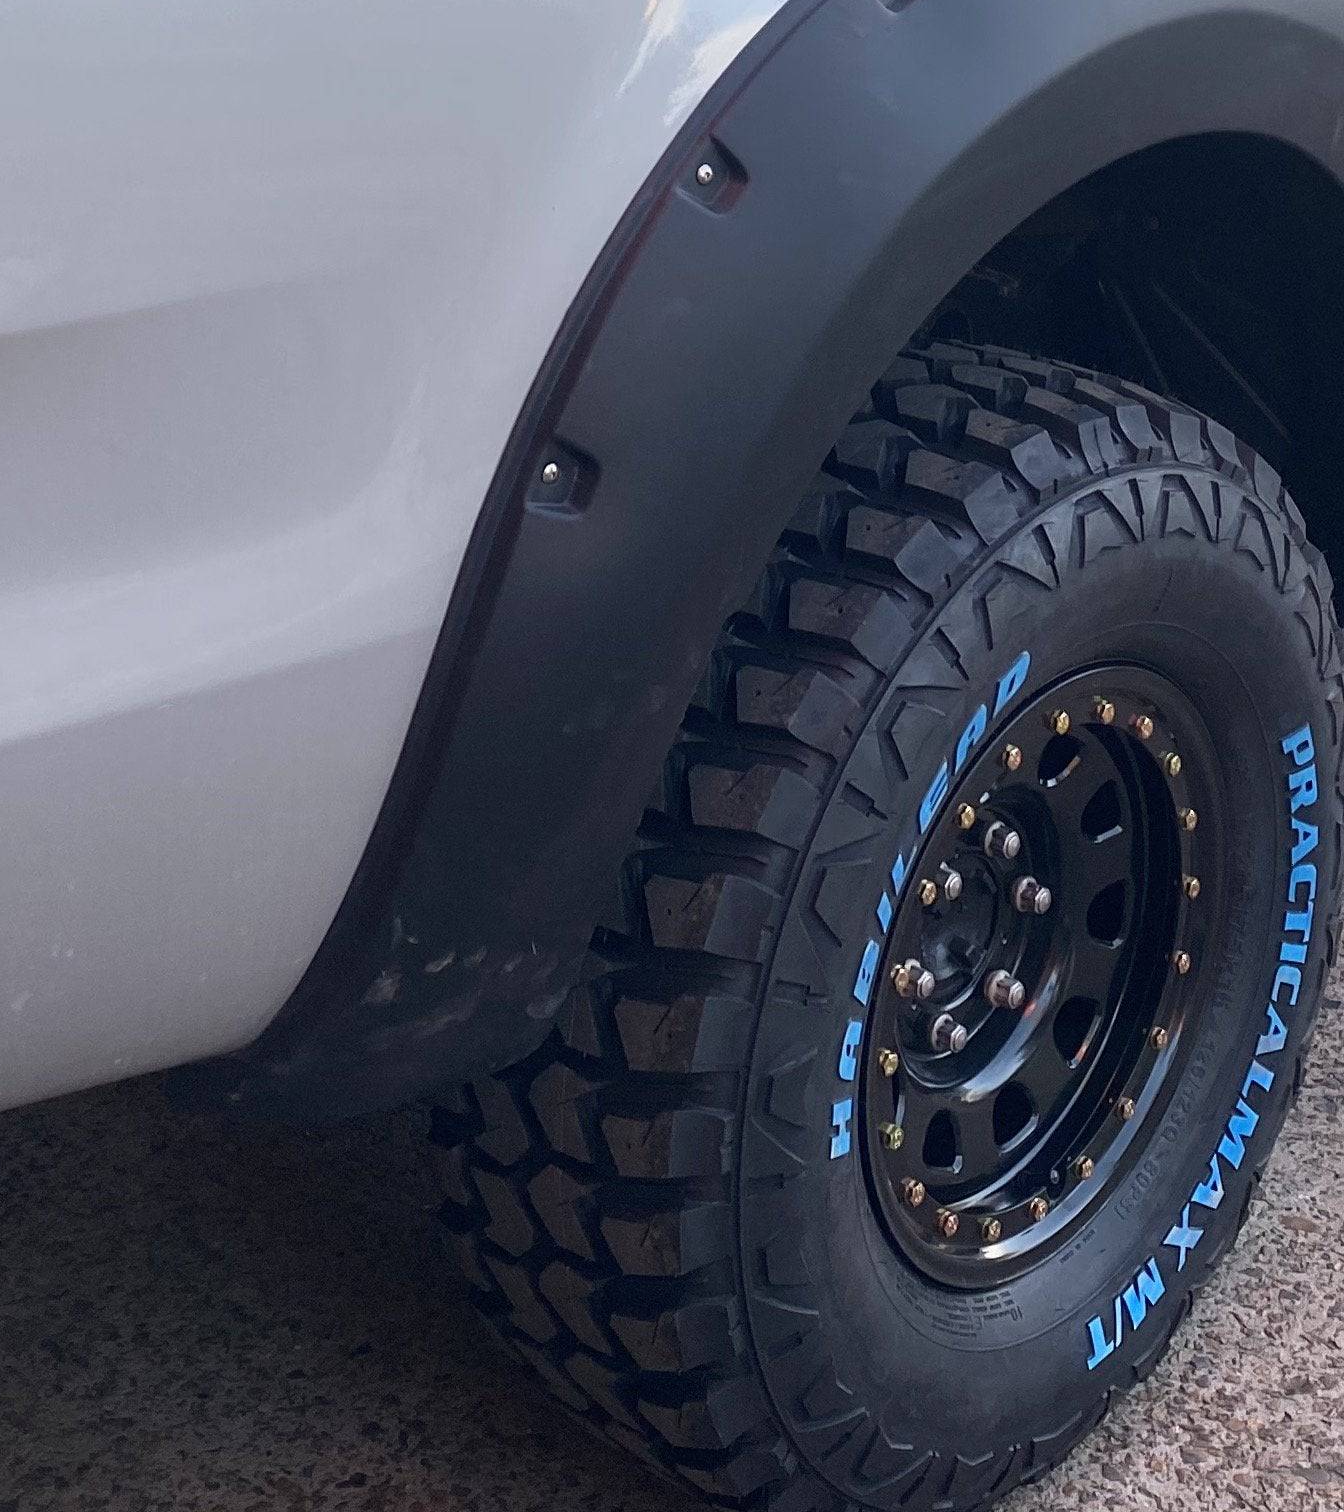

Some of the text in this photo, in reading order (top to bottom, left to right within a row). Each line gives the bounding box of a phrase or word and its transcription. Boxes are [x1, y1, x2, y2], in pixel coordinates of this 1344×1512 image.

[830, 651, 1031, 1159] HABILEAD
[1086, 724, 1319, 1370] PRACTICALMAX M/T
